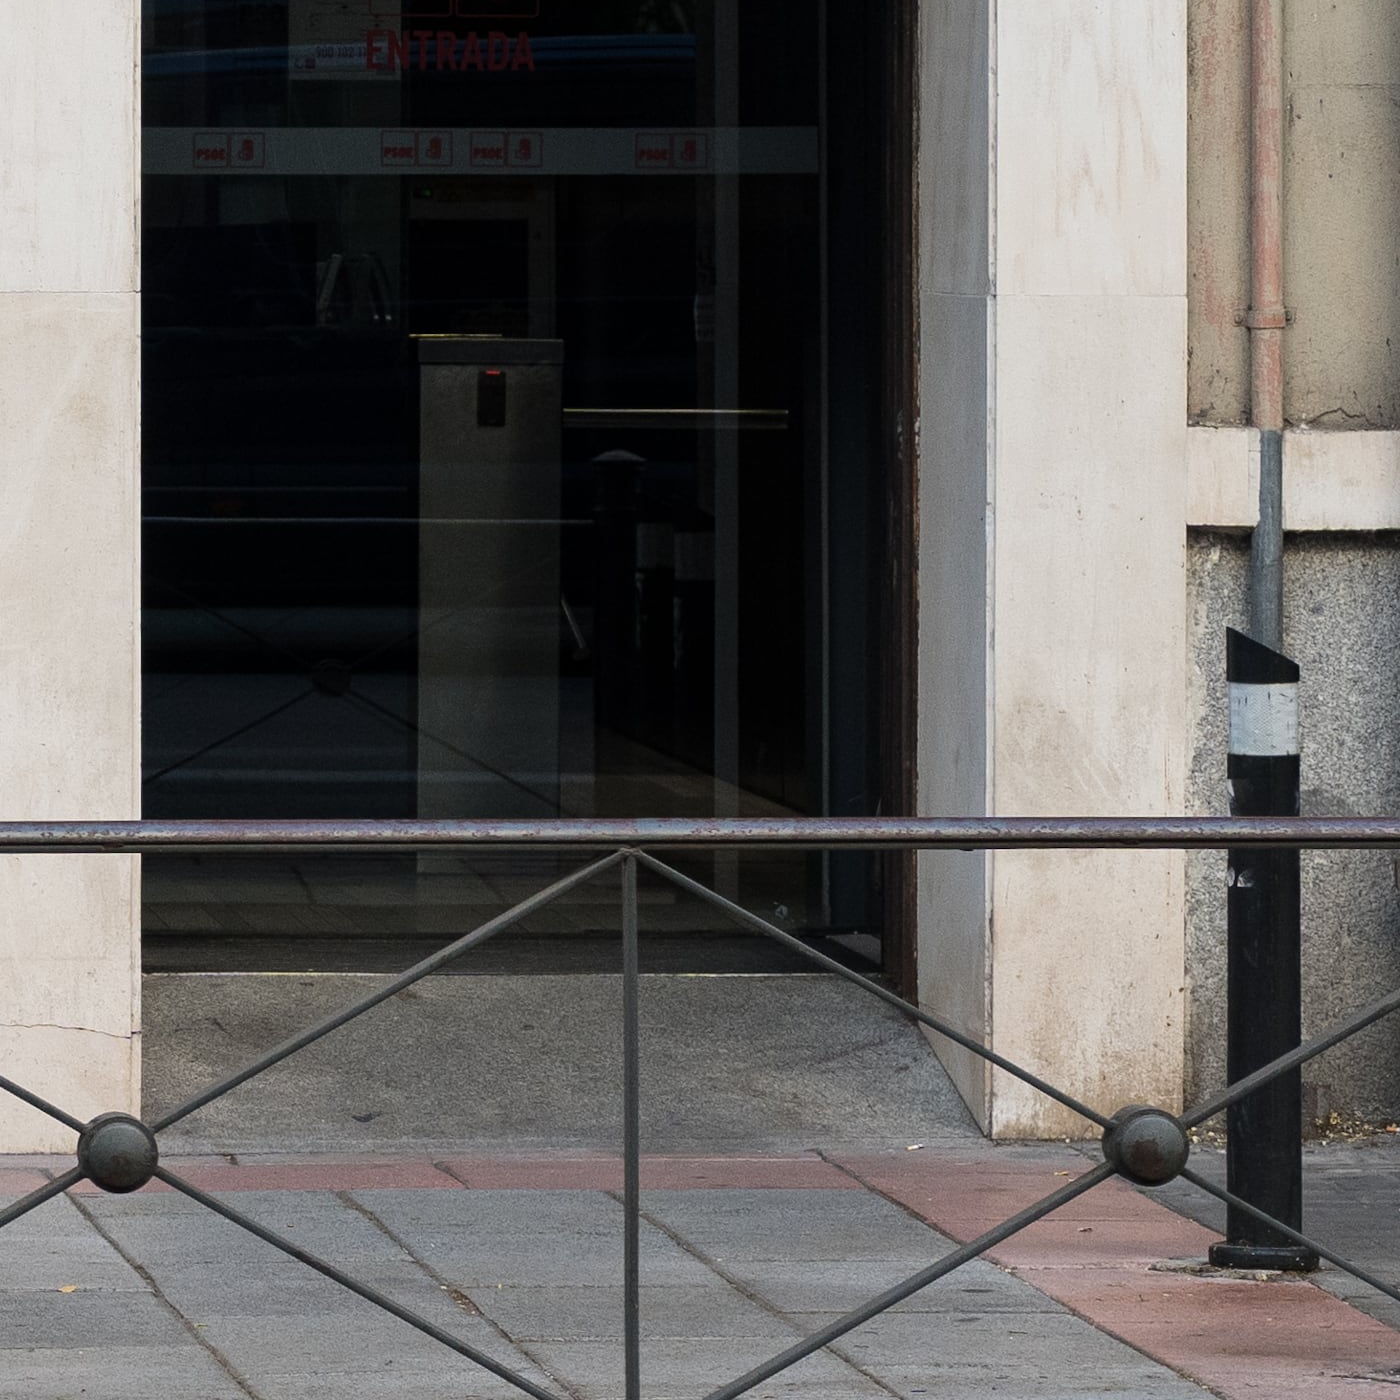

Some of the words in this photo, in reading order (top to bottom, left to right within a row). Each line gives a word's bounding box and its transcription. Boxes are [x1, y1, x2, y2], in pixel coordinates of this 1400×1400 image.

[365, 28, 536, 72] ENTRADA
[196, 147, 225, 160] PSOE
[383, 146, 416, 160] PSOE
[471, 146, 505, 160] PSOE
[638, 147, 670, 162] PSOE
